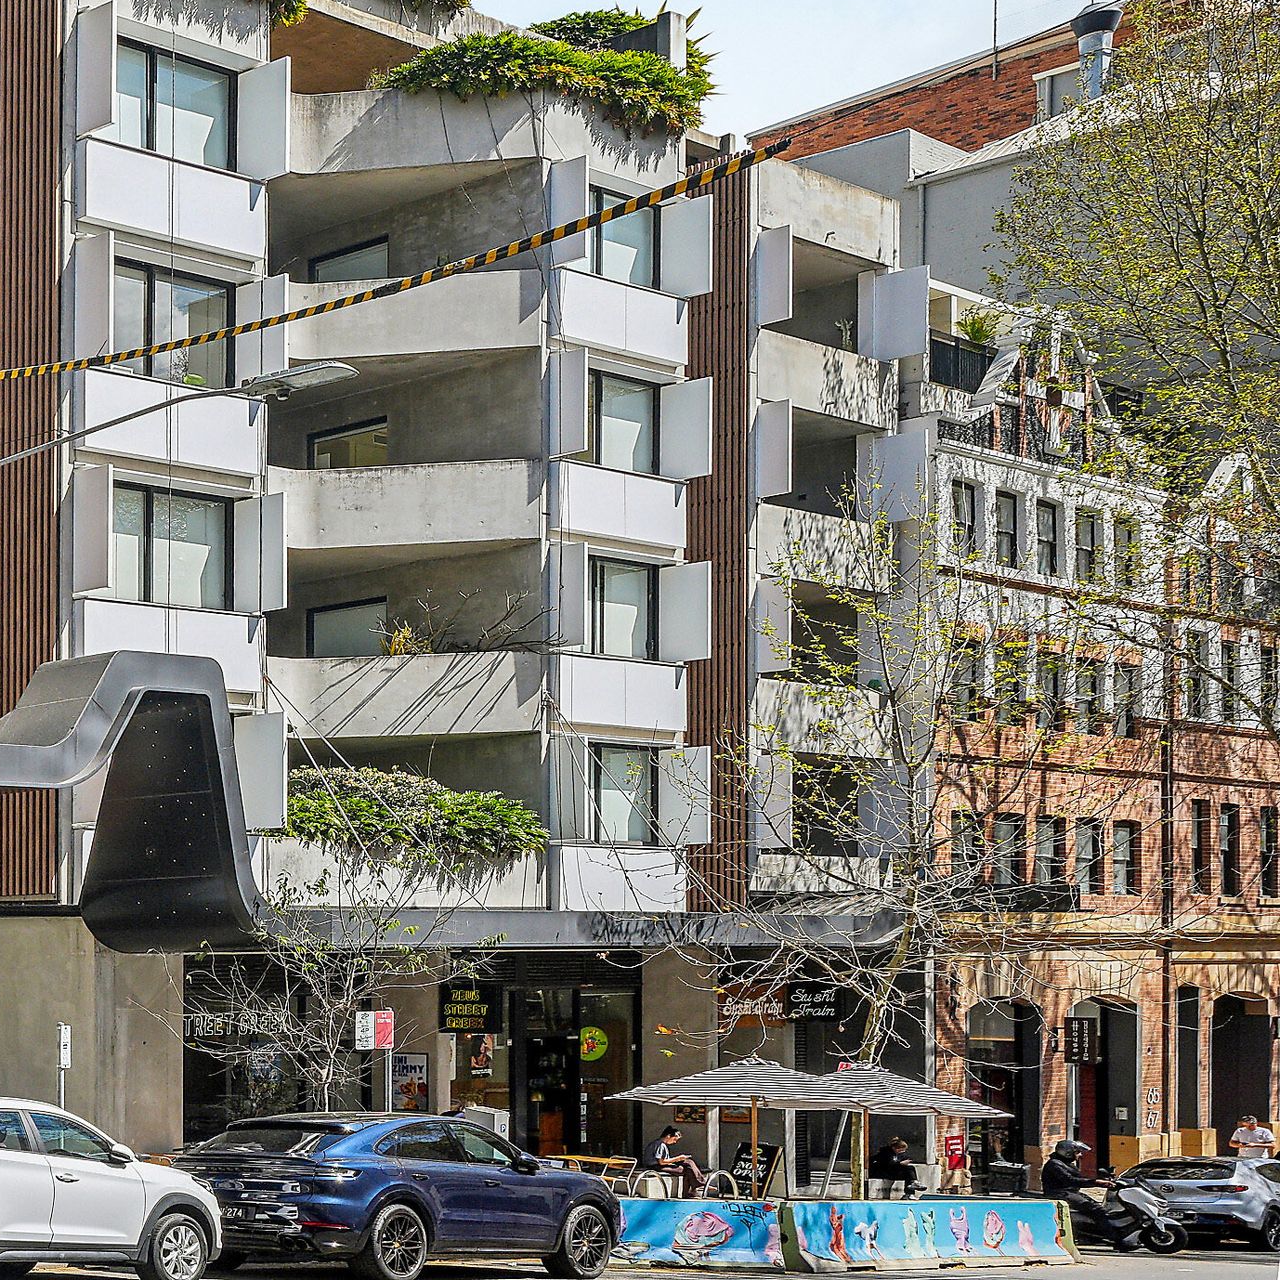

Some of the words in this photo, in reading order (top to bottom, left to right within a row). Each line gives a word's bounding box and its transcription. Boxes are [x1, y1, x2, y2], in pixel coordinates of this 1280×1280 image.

[451, 990, 480, 1001] ZEUS
[791, 989, 836, 1003] Sushi
[444, 1004, 488, 1015] STREET
[792, 1003, 836, 1017] Train
[183, 1013, 234, 1036] TREET
[1147, 1088, 1160, 1104] 65
[1146, 1111, 1160, 1128] 67
